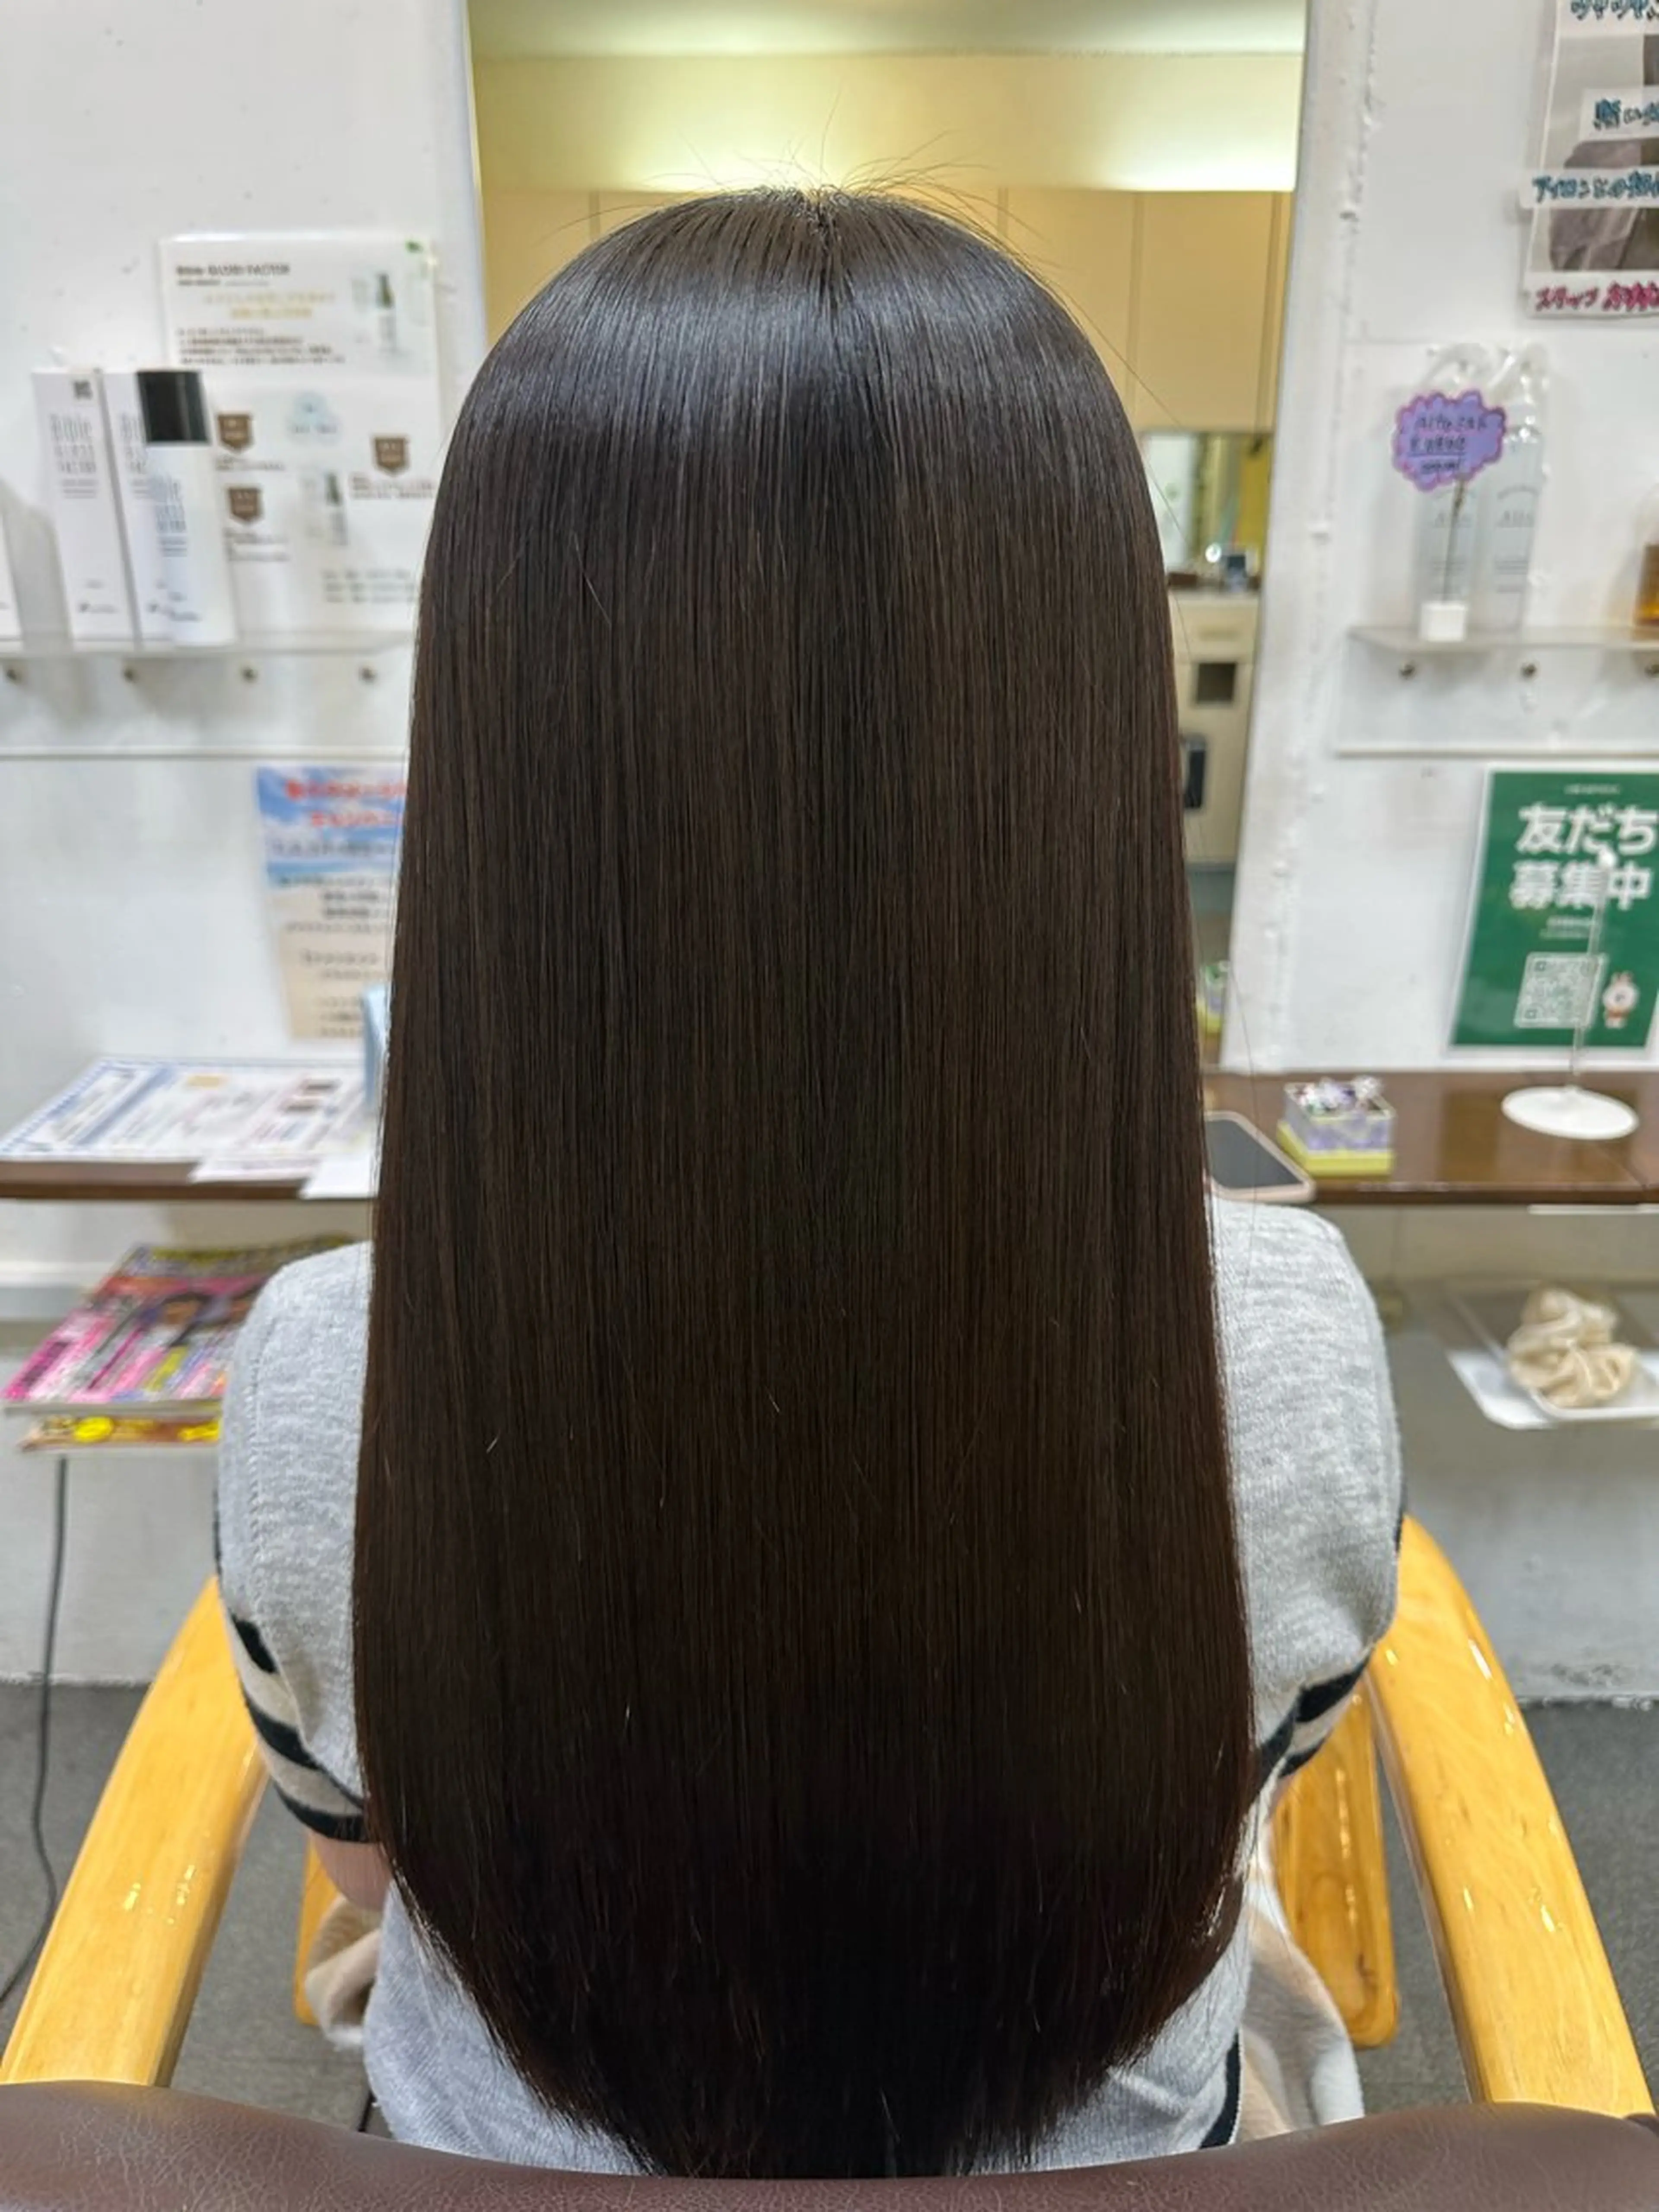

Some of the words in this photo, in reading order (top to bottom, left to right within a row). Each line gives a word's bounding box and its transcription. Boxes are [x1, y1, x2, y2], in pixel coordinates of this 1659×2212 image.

[1516, 802, 1658, 855] 友だち
[1509, 860, 1652, 911] 募集中
